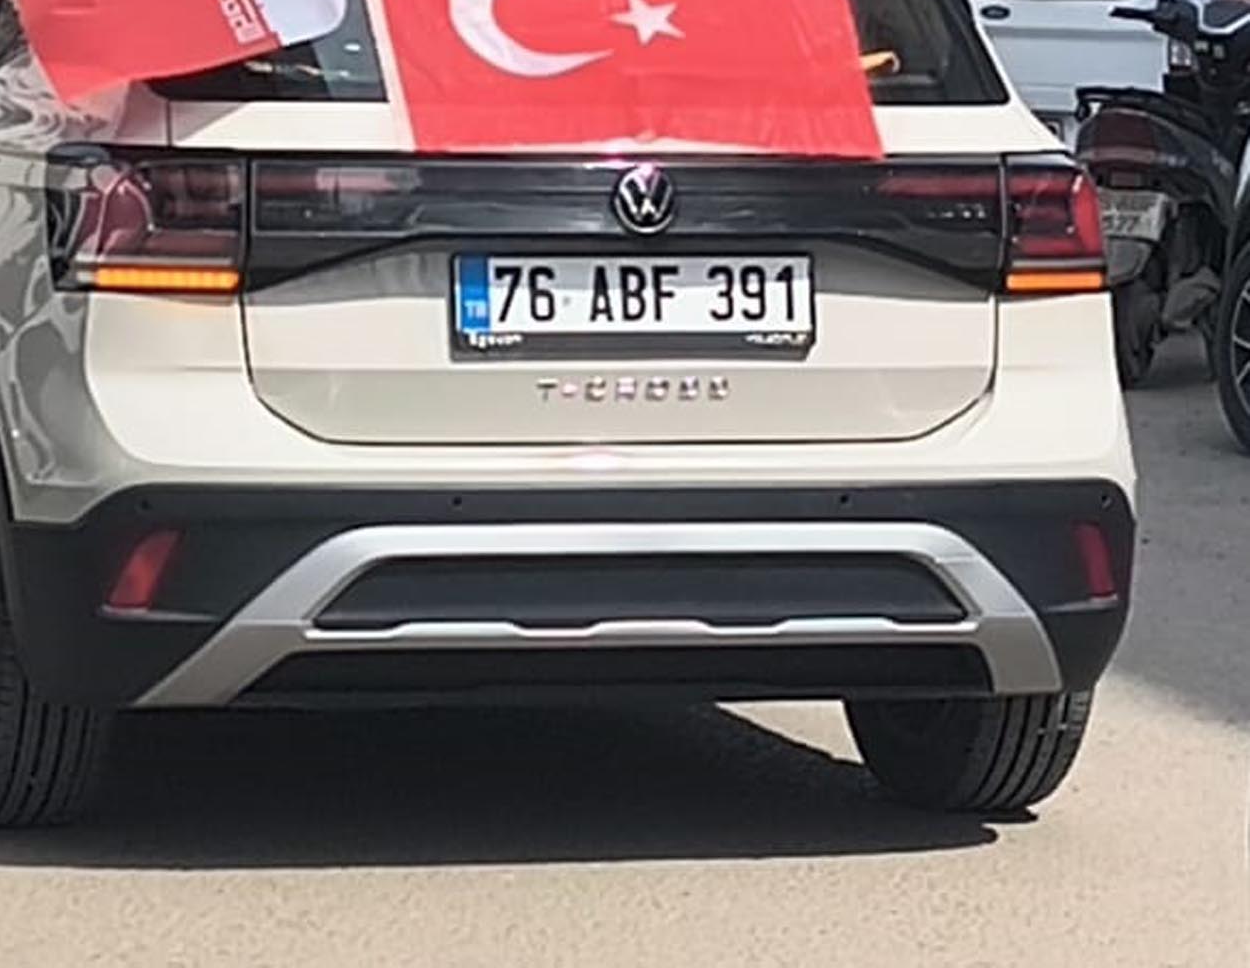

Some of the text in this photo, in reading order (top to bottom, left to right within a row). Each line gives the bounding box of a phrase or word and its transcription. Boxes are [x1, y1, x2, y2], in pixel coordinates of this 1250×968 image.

[495, 265, 795, 322] 76 ABF 391
